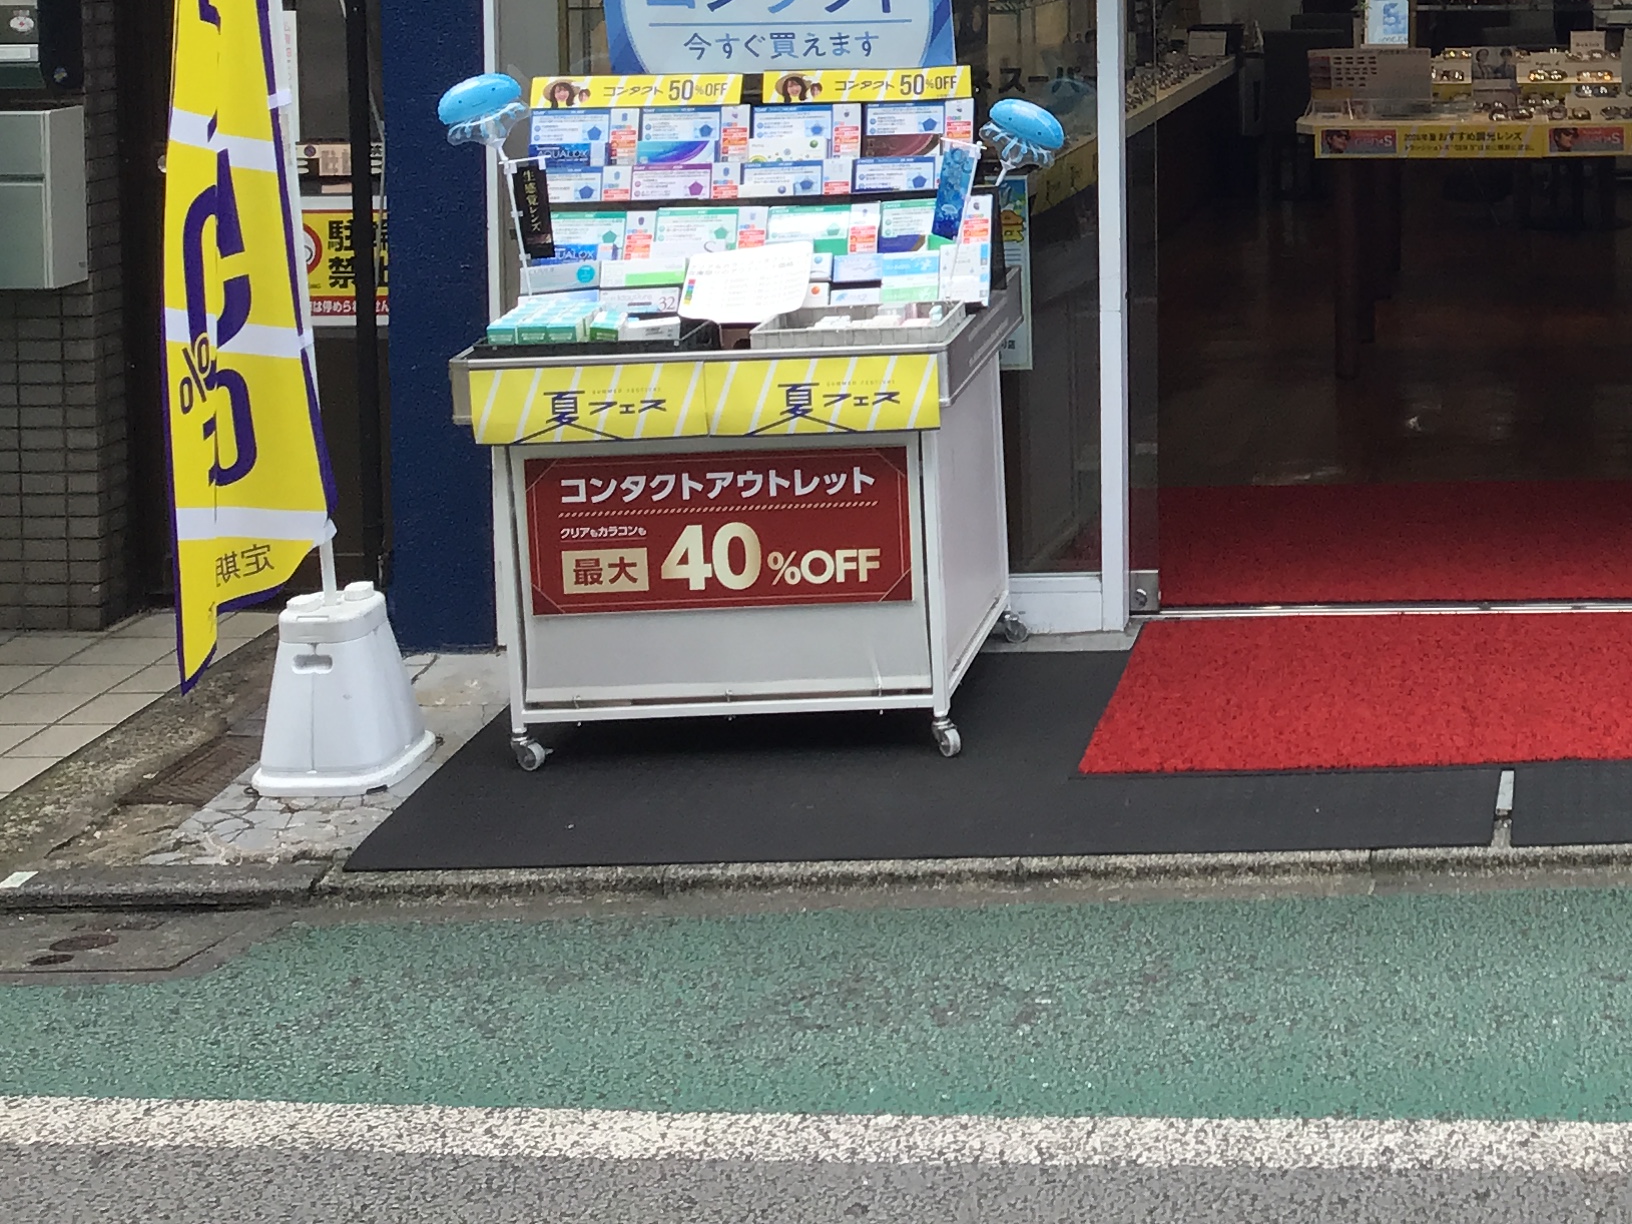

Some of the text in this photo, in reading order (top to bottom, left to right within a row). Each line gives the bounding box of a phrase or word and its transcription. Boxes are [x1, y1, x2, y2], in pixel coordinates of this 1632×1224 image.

[683, 32, 879, 59] 今すぐ買えます
[603, 85, 663, 97] コンタクト
[835, 80, 895, 91] コンタクト
[659, 296, 676, 310] 32
[542, 390, 667, 429] 夏フェス
[776, 382, 900, 421] 夏フェス
[560, 466, 876, 505] コンタクトアウトレット
[572, 554, 639, 587] 最大
